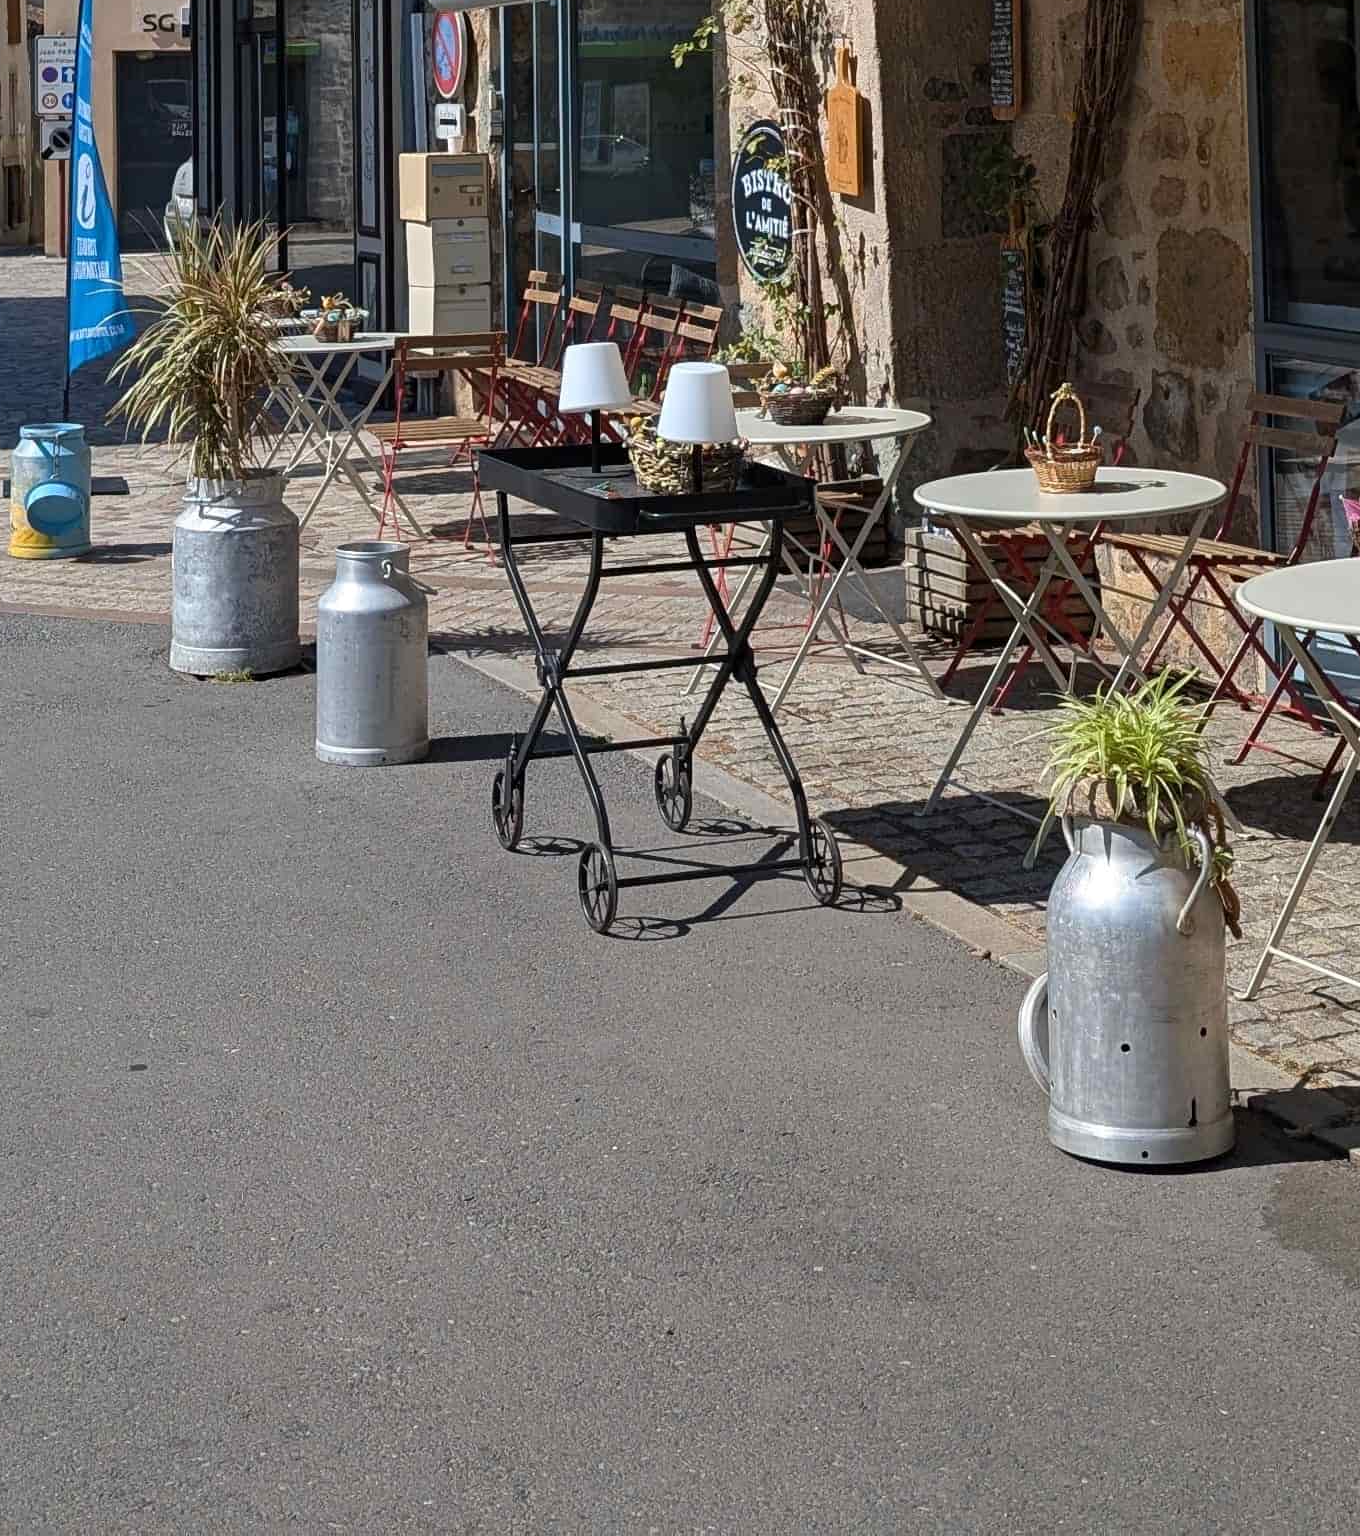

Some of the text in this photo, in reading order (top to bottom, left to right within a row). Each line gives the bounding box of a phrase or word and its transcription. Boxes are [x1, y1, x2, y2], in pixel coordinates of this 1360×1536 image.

[143, 14, 175, 32] SG
[741, 168, 792, 205] BISTRO
[761, 197, 773, 212] DE
[745, 210, 790, 239] L'AMITIÉ
